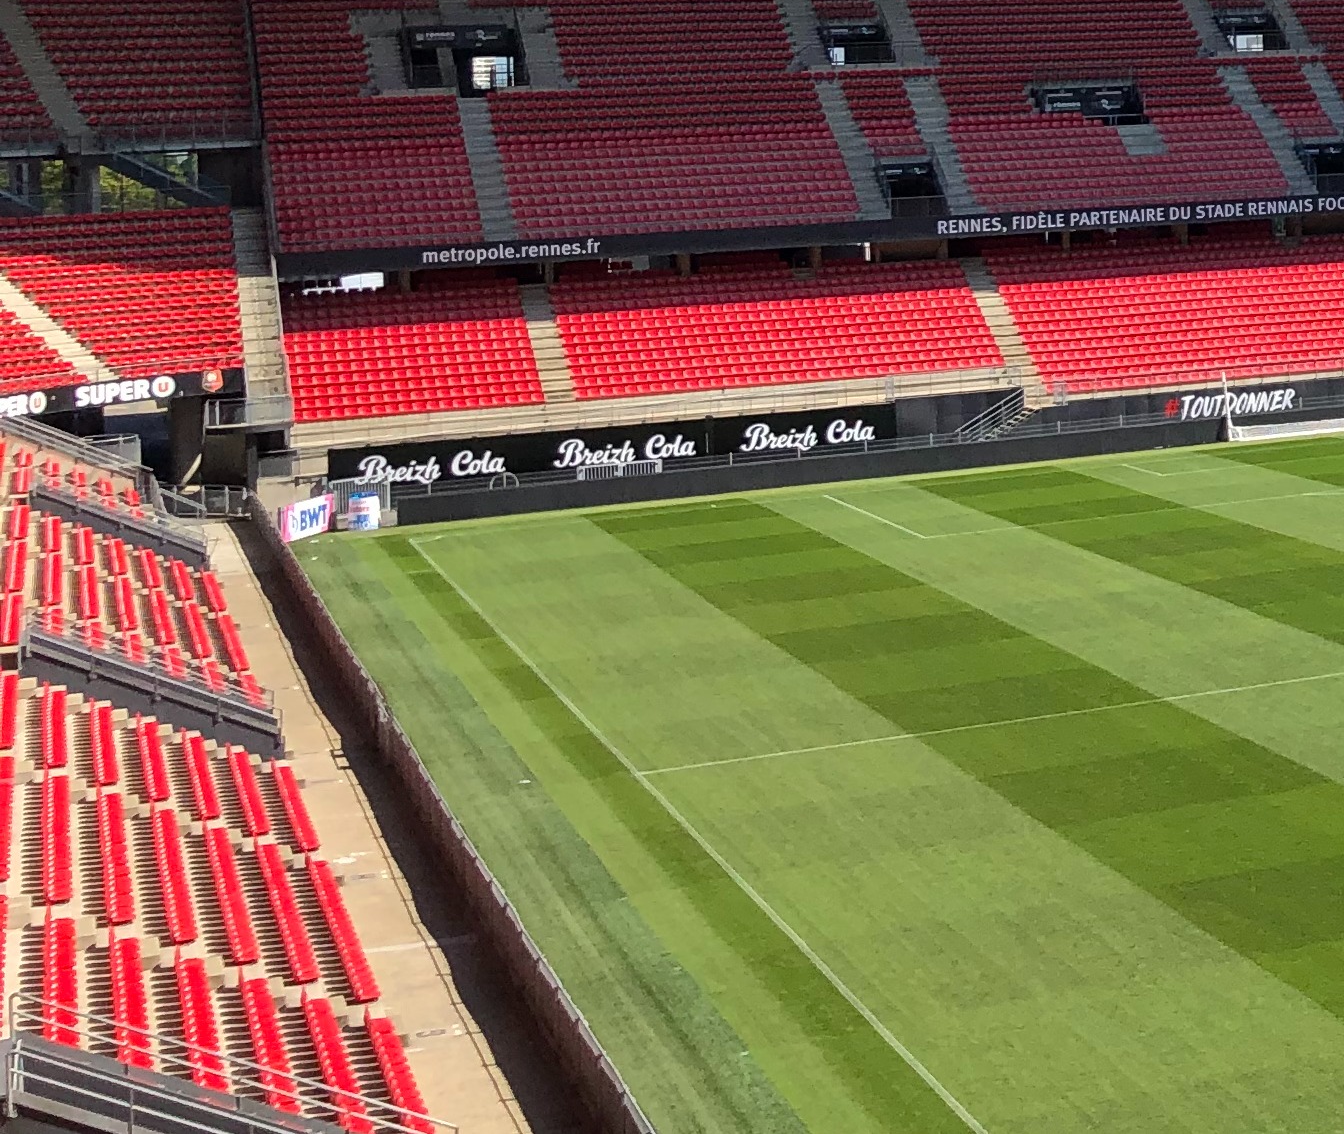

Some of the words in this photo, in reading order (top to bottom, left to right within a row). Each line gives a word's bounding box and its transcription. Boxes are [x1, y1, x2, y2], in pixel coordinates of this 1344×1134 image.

[937, 216, 1007, 235] RENNES,
[1012, 210, 1066, 230] FIDÈLE
[1070, 206, 1165, 226] PARTENAIRE
[1170, 205, 1191, 221] DU
[1196, 202, 1244, 219] STADE
[1249, 197, 1314, 216] RENNAIS
[422, 238, 601, 265] metropole.rennes.fr
[75, 379, 151, 407] SUPER
[1164, 388, 1296, 421] #TOUTDONNER
[553, 438, 635, 468] Breizh
[645, 434, 696, 459] Cola
[739, 422, 818, 451] Breizh
[826, 418, 875, 443] Cola
[354, 455, 442, 484] Breizh
[451, 450, 507, 476] Cola
[300, 504, 328, 531] BWT
